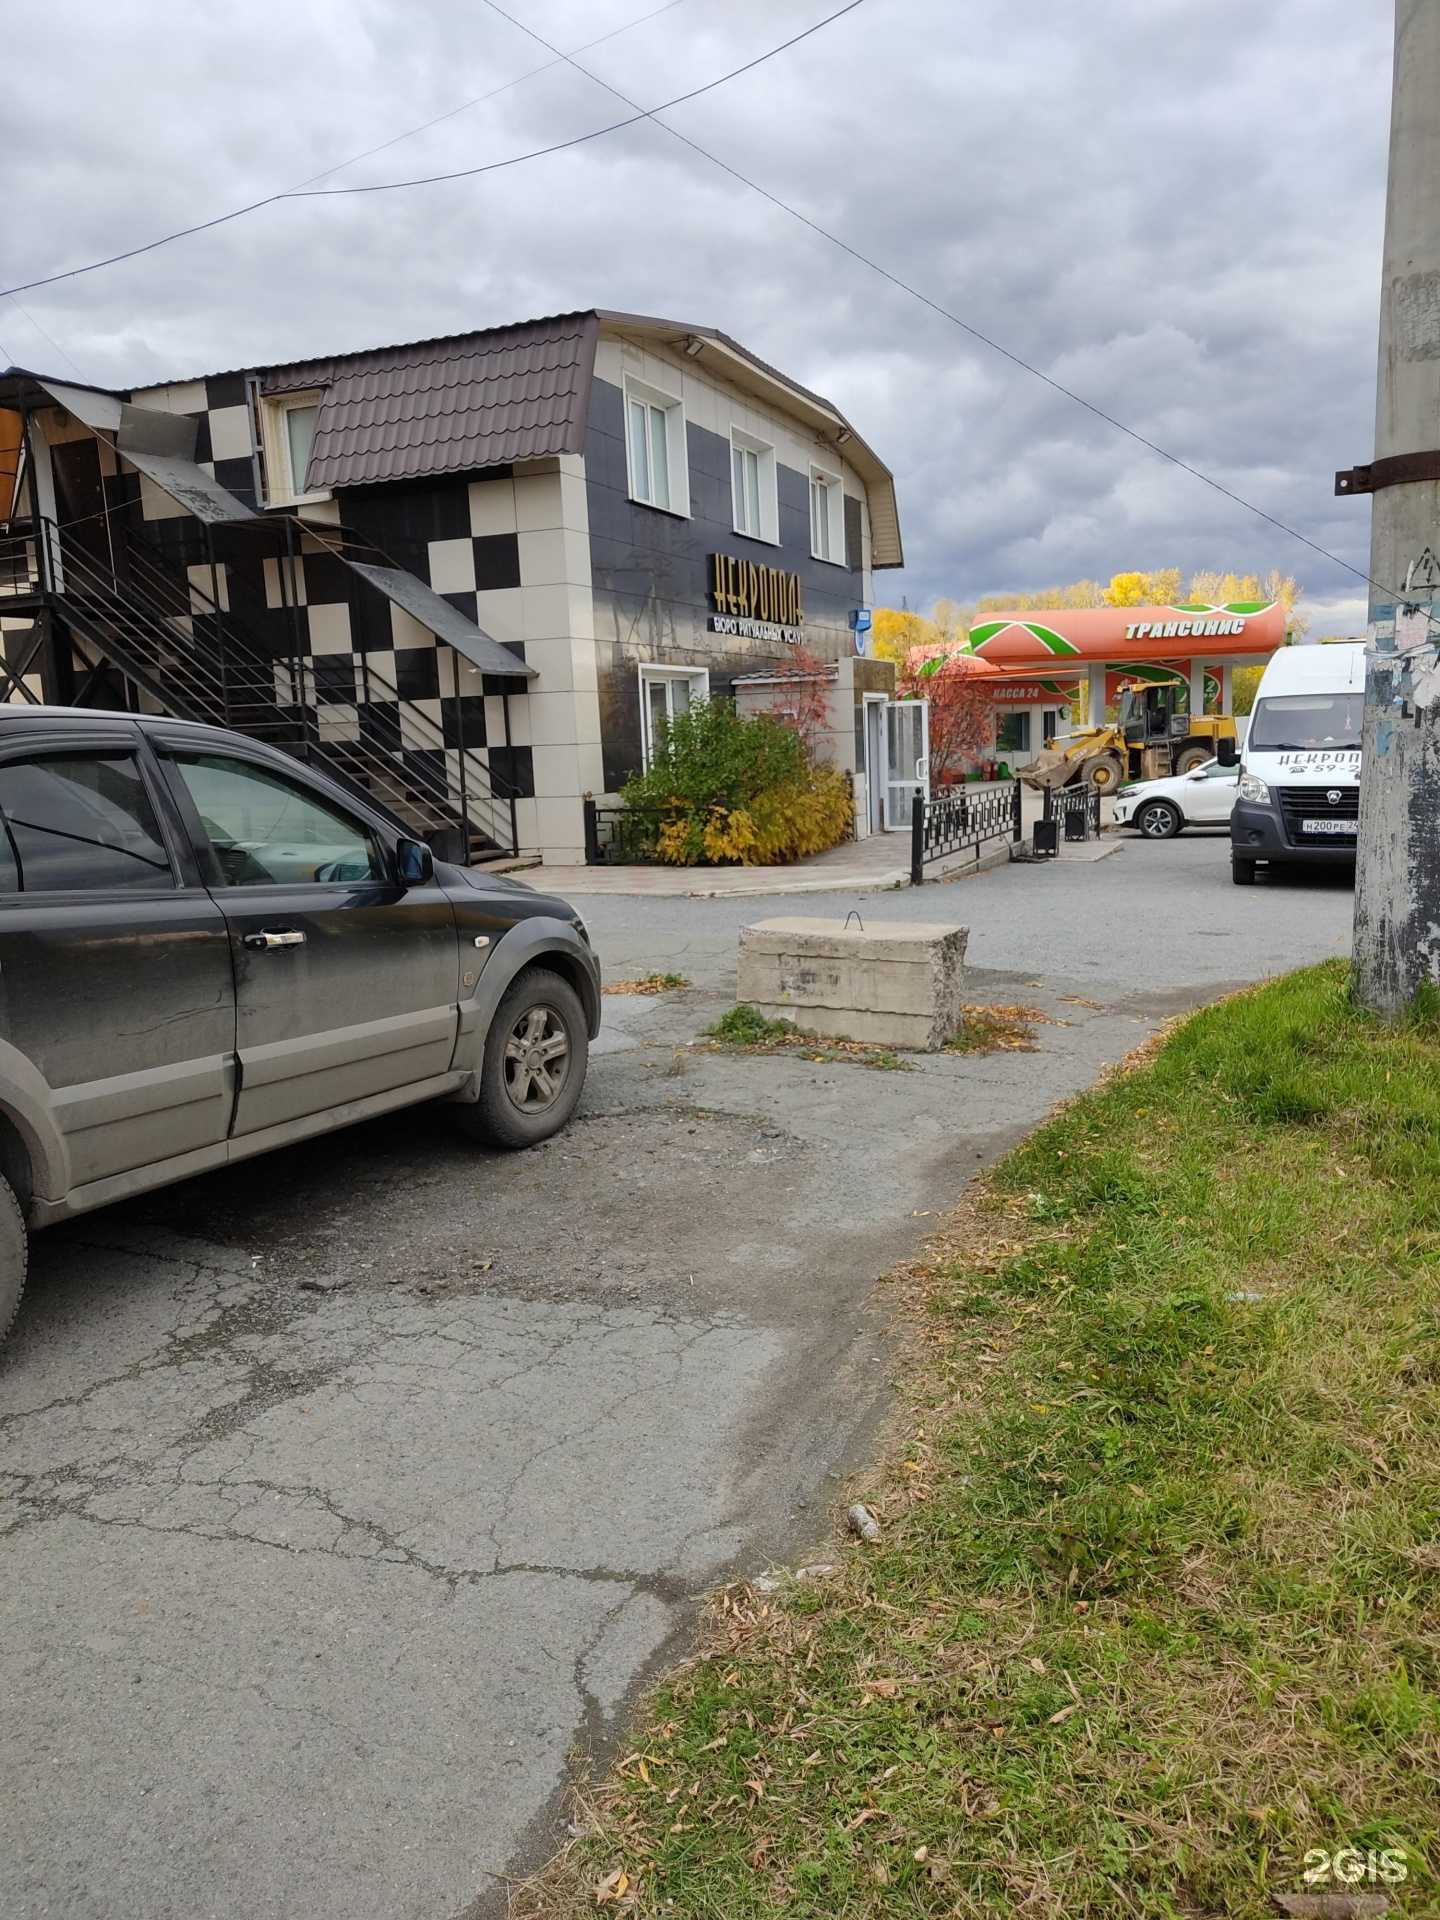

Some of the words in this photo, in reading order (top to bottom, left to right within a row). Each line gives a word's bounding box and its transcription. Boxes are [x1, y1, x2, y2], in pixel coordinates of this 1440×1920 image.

[713, 617, 737, 635] БЮРО
[1125, 619, 1245, 640] ТРАНСОНИС
[1026, 687, 1040, 698] 24
[1278, 753, 1360, 766] НЕКРОП
